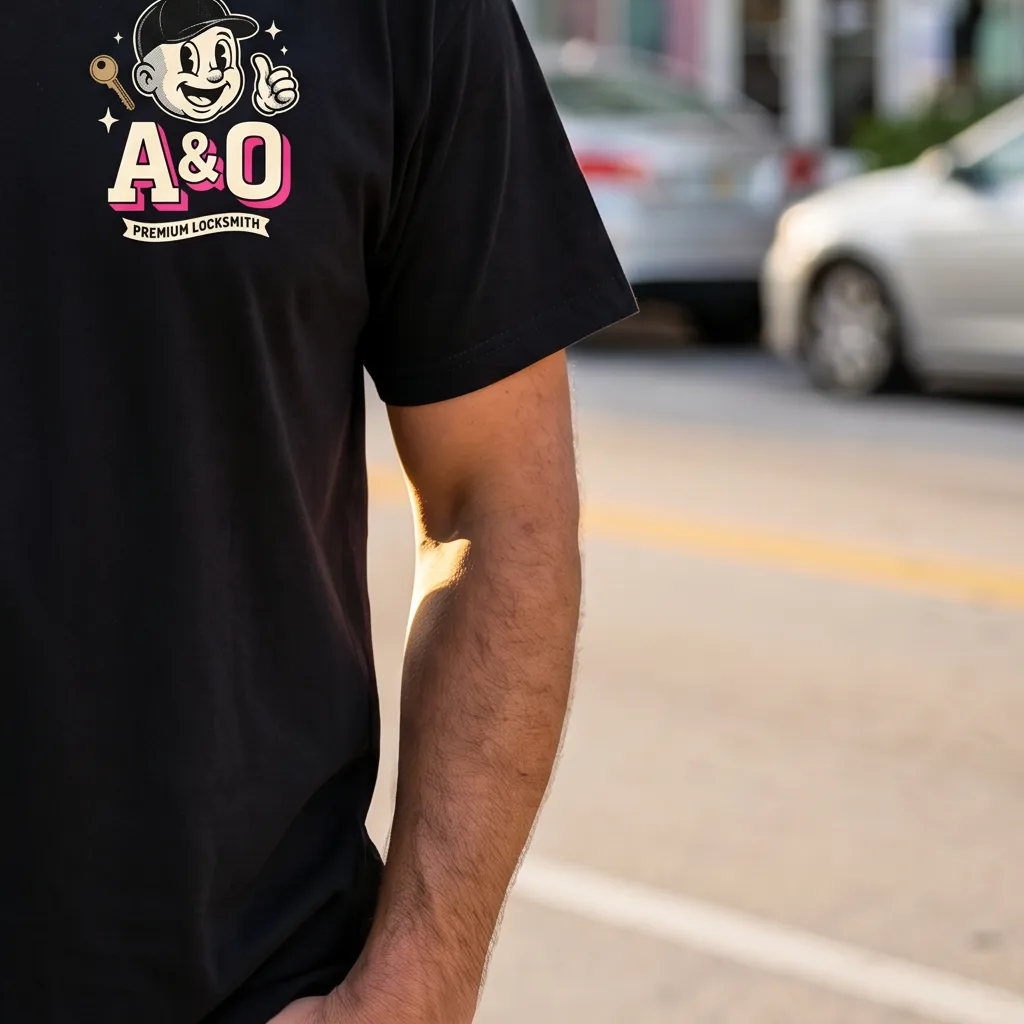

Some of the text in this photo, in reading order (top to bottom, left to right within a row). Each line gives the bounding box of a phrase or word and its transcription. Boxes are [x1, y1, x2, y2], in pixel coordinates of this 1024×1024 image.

[107, 121, 291, 211] A&O
[133, 215, 260, 239] PREMIUM LOCKSMITH
